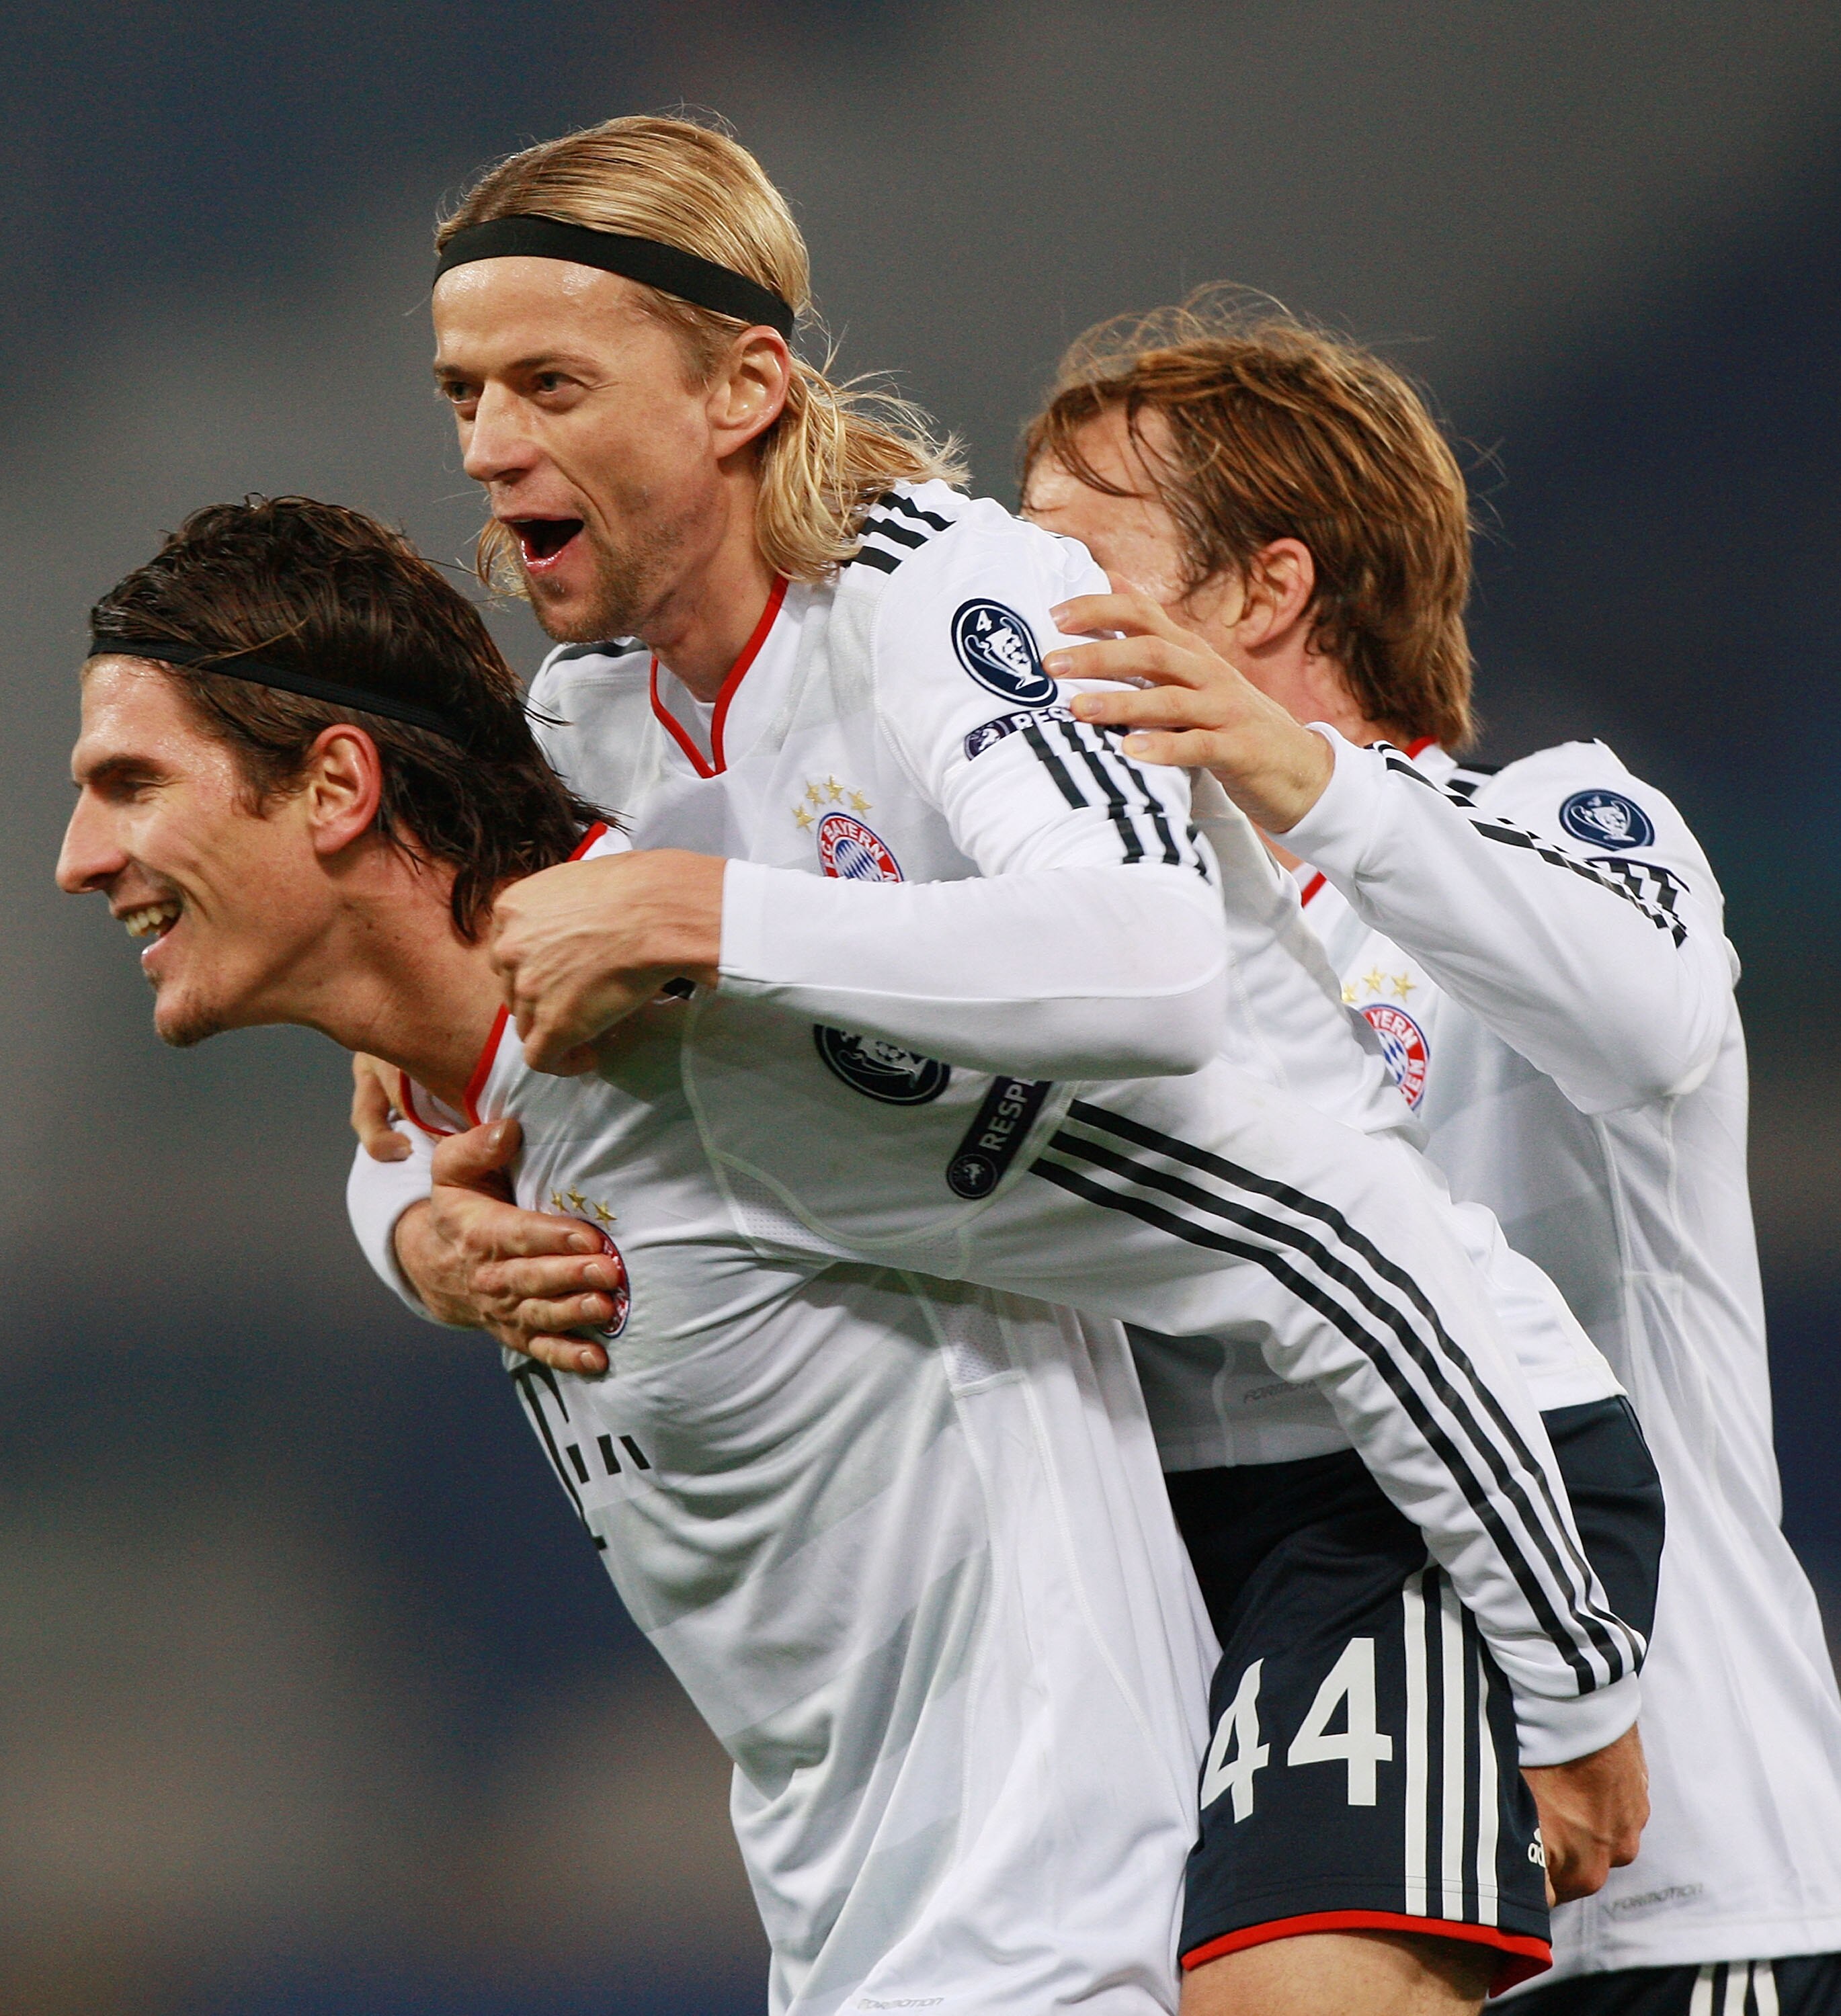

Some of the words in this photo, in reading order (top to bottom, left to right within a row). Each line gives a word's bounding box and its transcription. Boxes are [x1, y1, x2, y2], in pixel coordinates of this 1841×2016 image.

[976, 610, 992, 632] 4
[823, 820, 886, 860] BAYERN
[979, 1077, 1036, 1151] RESP
[1200, 1637, 1393, 1824] 44
